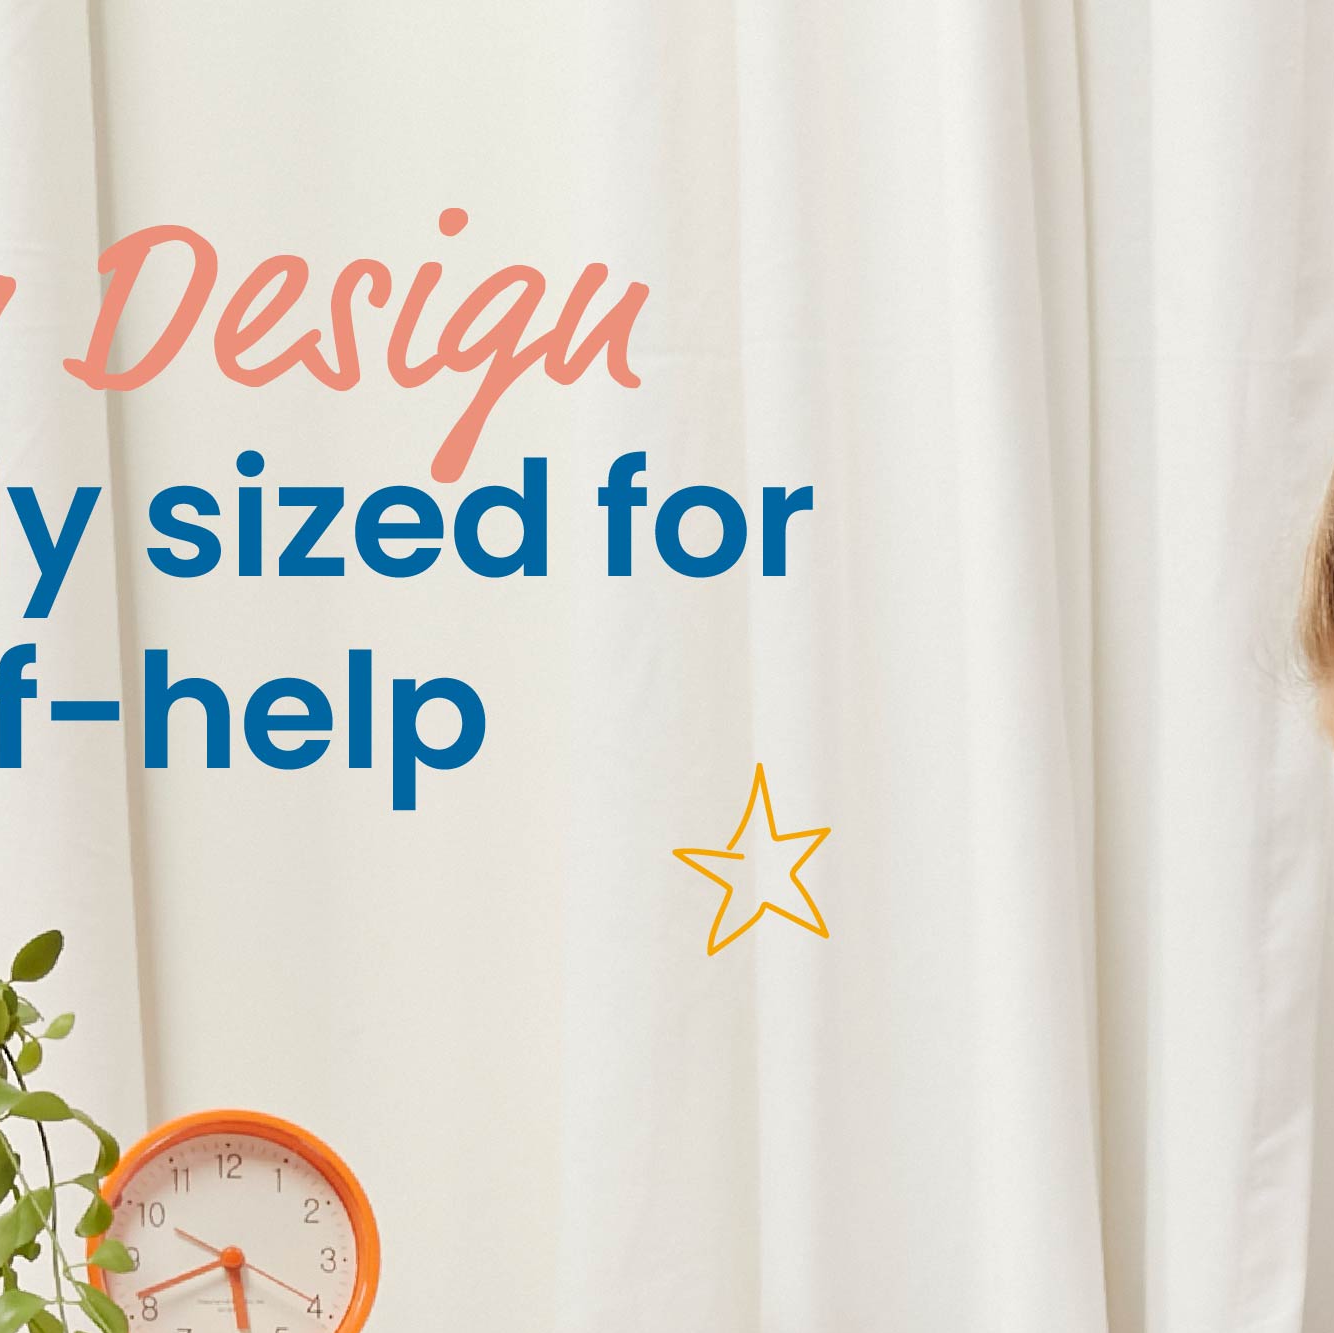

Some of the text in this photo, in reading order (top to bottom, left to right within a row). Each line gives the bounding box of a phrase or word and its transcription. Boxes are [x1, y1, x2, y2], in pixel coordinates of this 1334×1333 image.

[217, 1154, 243, 1179] 12
[172, 1167, 191, 1193] 11
[275, 1168, 281, 1192] 1
[137, 1202, 166, 1227] 10
[303, 1198, 320, 1224] 2
[320, 1248, 337, 1274] 3
[141, 1296, 159, 1322] 8
[306, 1294, 323, 1318] 4
